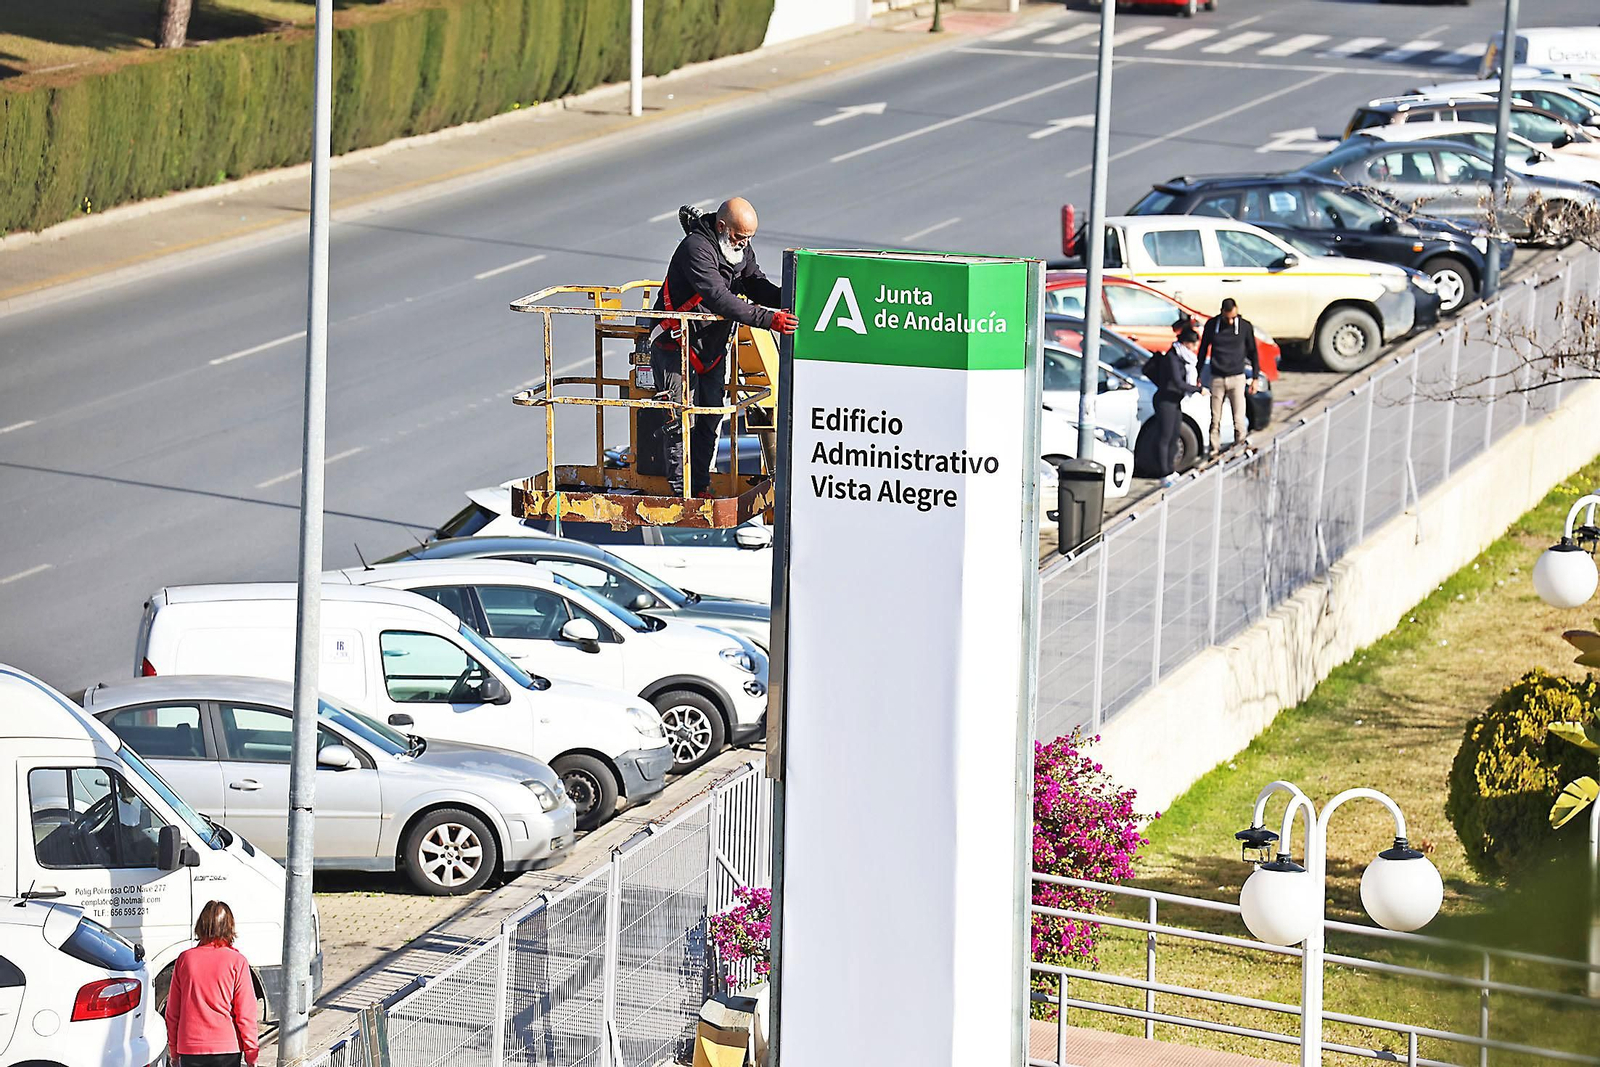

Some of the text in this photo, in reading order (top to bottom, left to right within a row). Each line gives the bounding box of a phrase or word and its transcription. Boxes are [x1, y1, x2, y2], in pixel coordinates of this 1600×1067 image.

[874, 284, 933, 306] Junta
[874, 309, 1007, 334] de Andalucía
[811, 407, 904, 436] Edificio
[811, 441, 999, 475] Administrativo
[811, 474, 958, 512] Vista Alegre
[110, 908, 123, 917] 656
